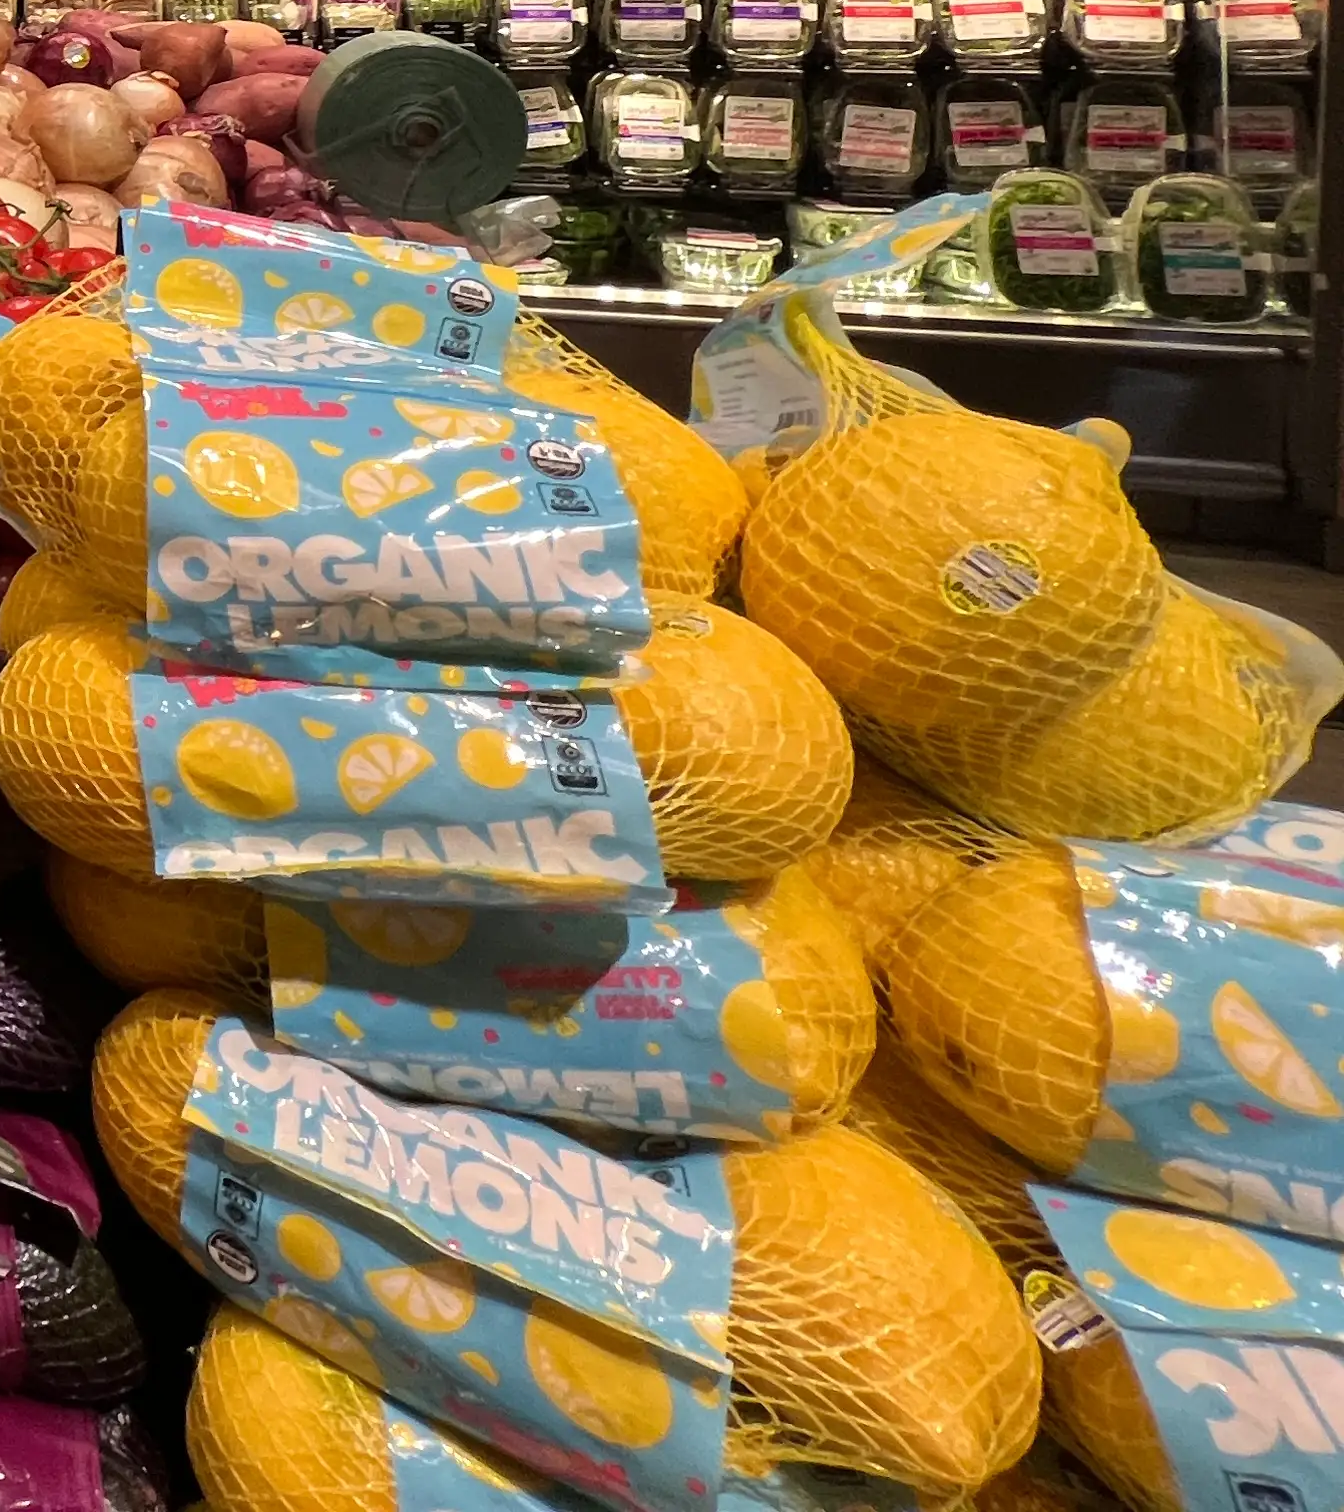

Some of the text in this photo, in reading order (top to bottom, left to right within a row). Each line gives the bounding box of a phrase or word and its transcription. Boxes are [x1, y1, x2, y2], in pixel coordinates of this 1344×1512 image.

[157, 530, 630, 603] ORGANIC
[226, 604, 592, 651] LEMONS
[357, 1059, 691, 1119] LEMON
[273, 1098, 673, 1285] LEMONS
